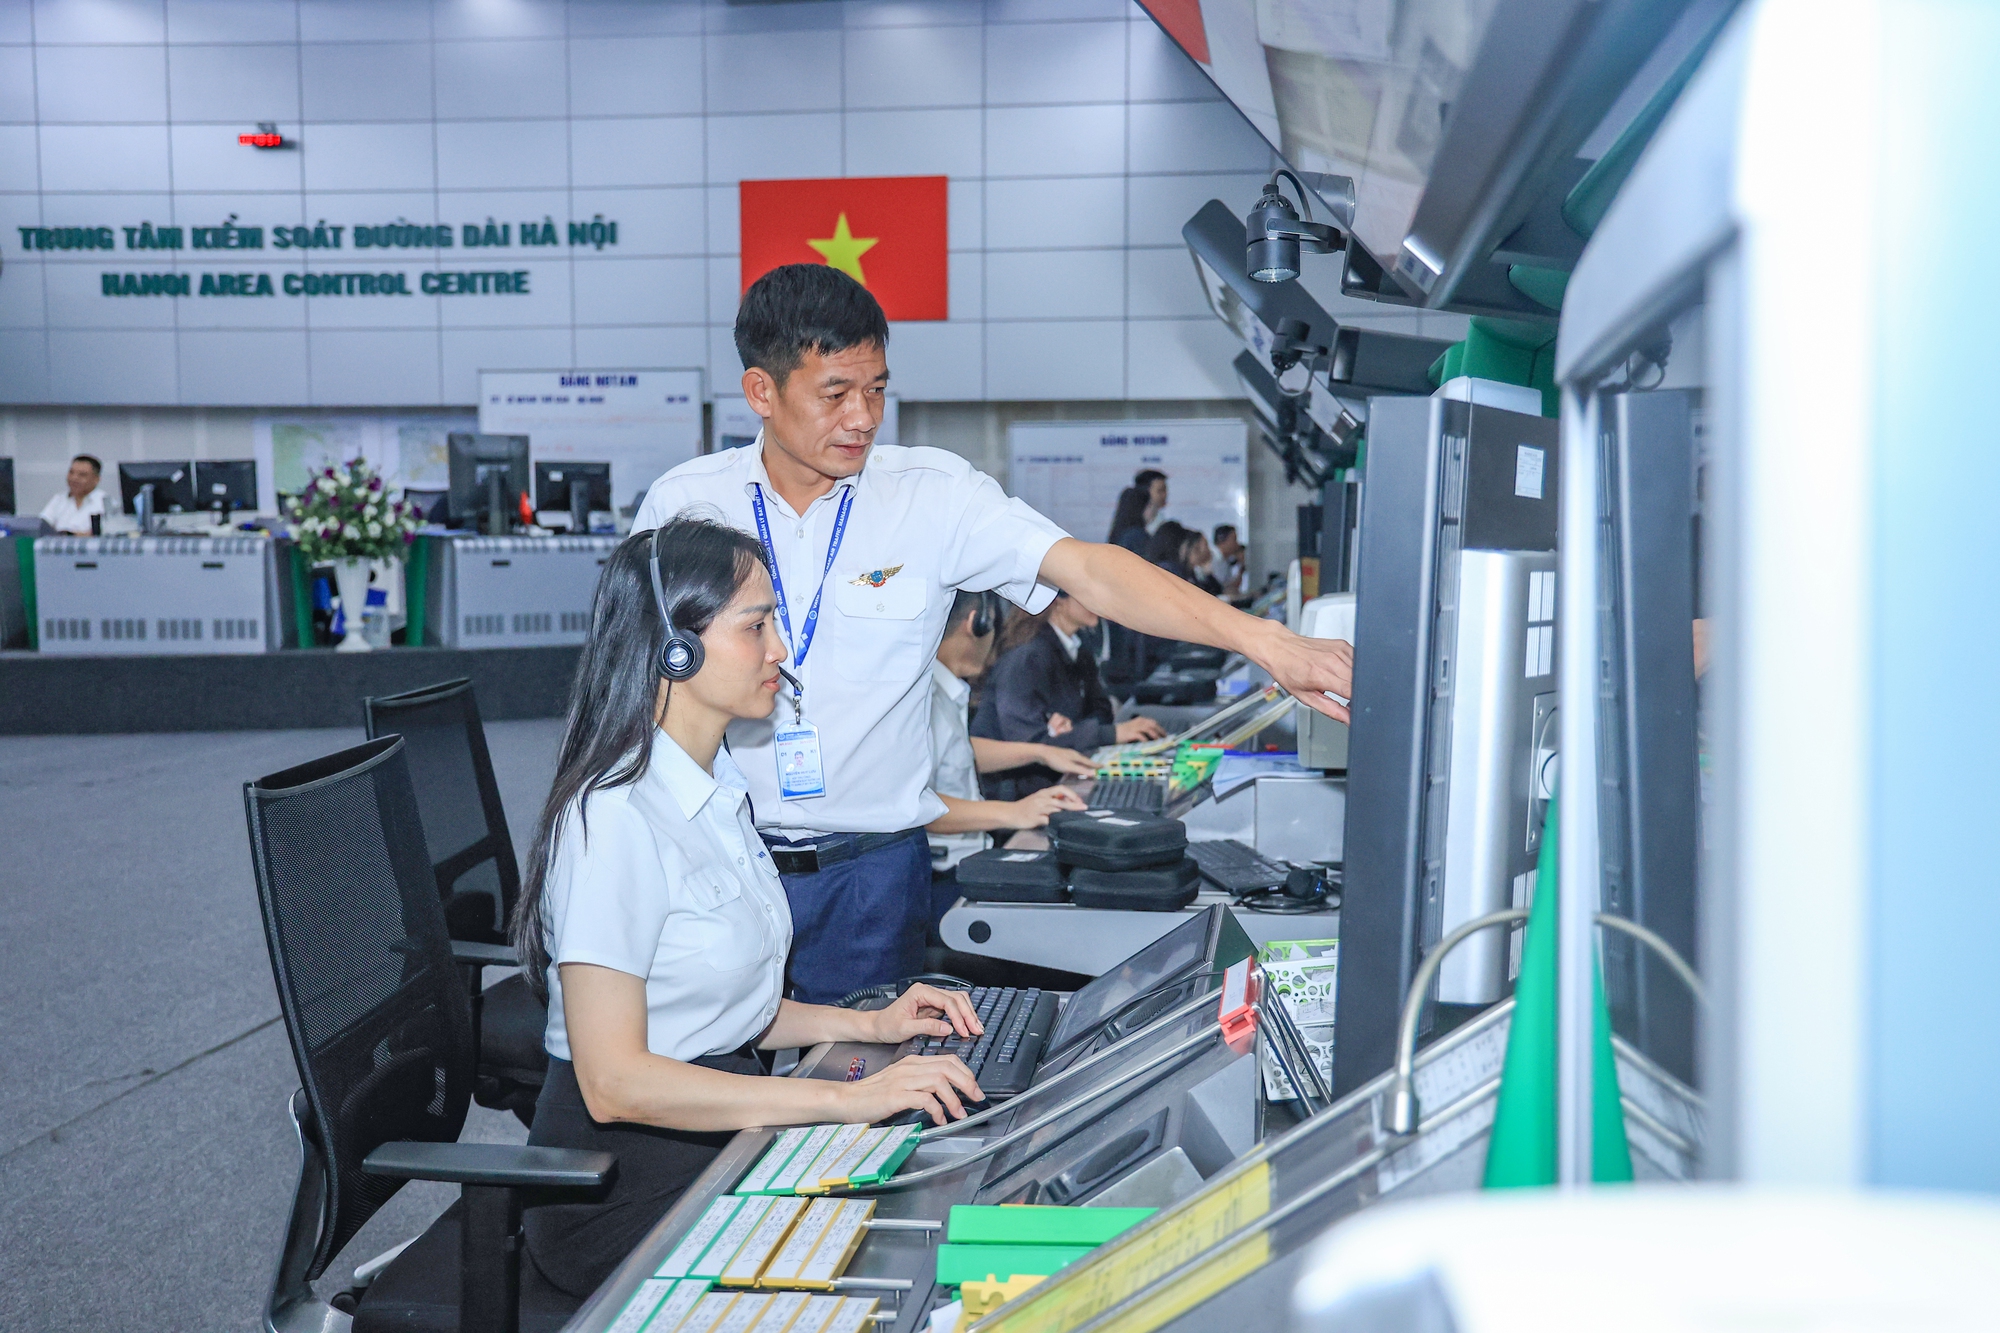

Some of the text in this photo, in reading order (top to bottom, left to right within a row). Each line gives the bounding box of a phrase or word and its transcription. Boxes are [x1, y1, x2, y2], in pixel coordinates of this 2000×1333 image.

[18, 225, 116, 250] TRUNG
[122, 220, 184, 250] TÂM
[191, 213, 264, 250] KIỂM
[272, 219, 345, 249] SOÁT
[461, 216, 511, 247] DÀI
[520, 215, 559, 246] HÀ
[568, 214, 619, 251] NỘI
[101, 270, 531, 297] HANOI AREA CONTROL CENTRE
[832, 526, 842, 547] TRAFFIC
[776, 590, 784, 606] VATM
[812, 594, 820, 609] VATM
